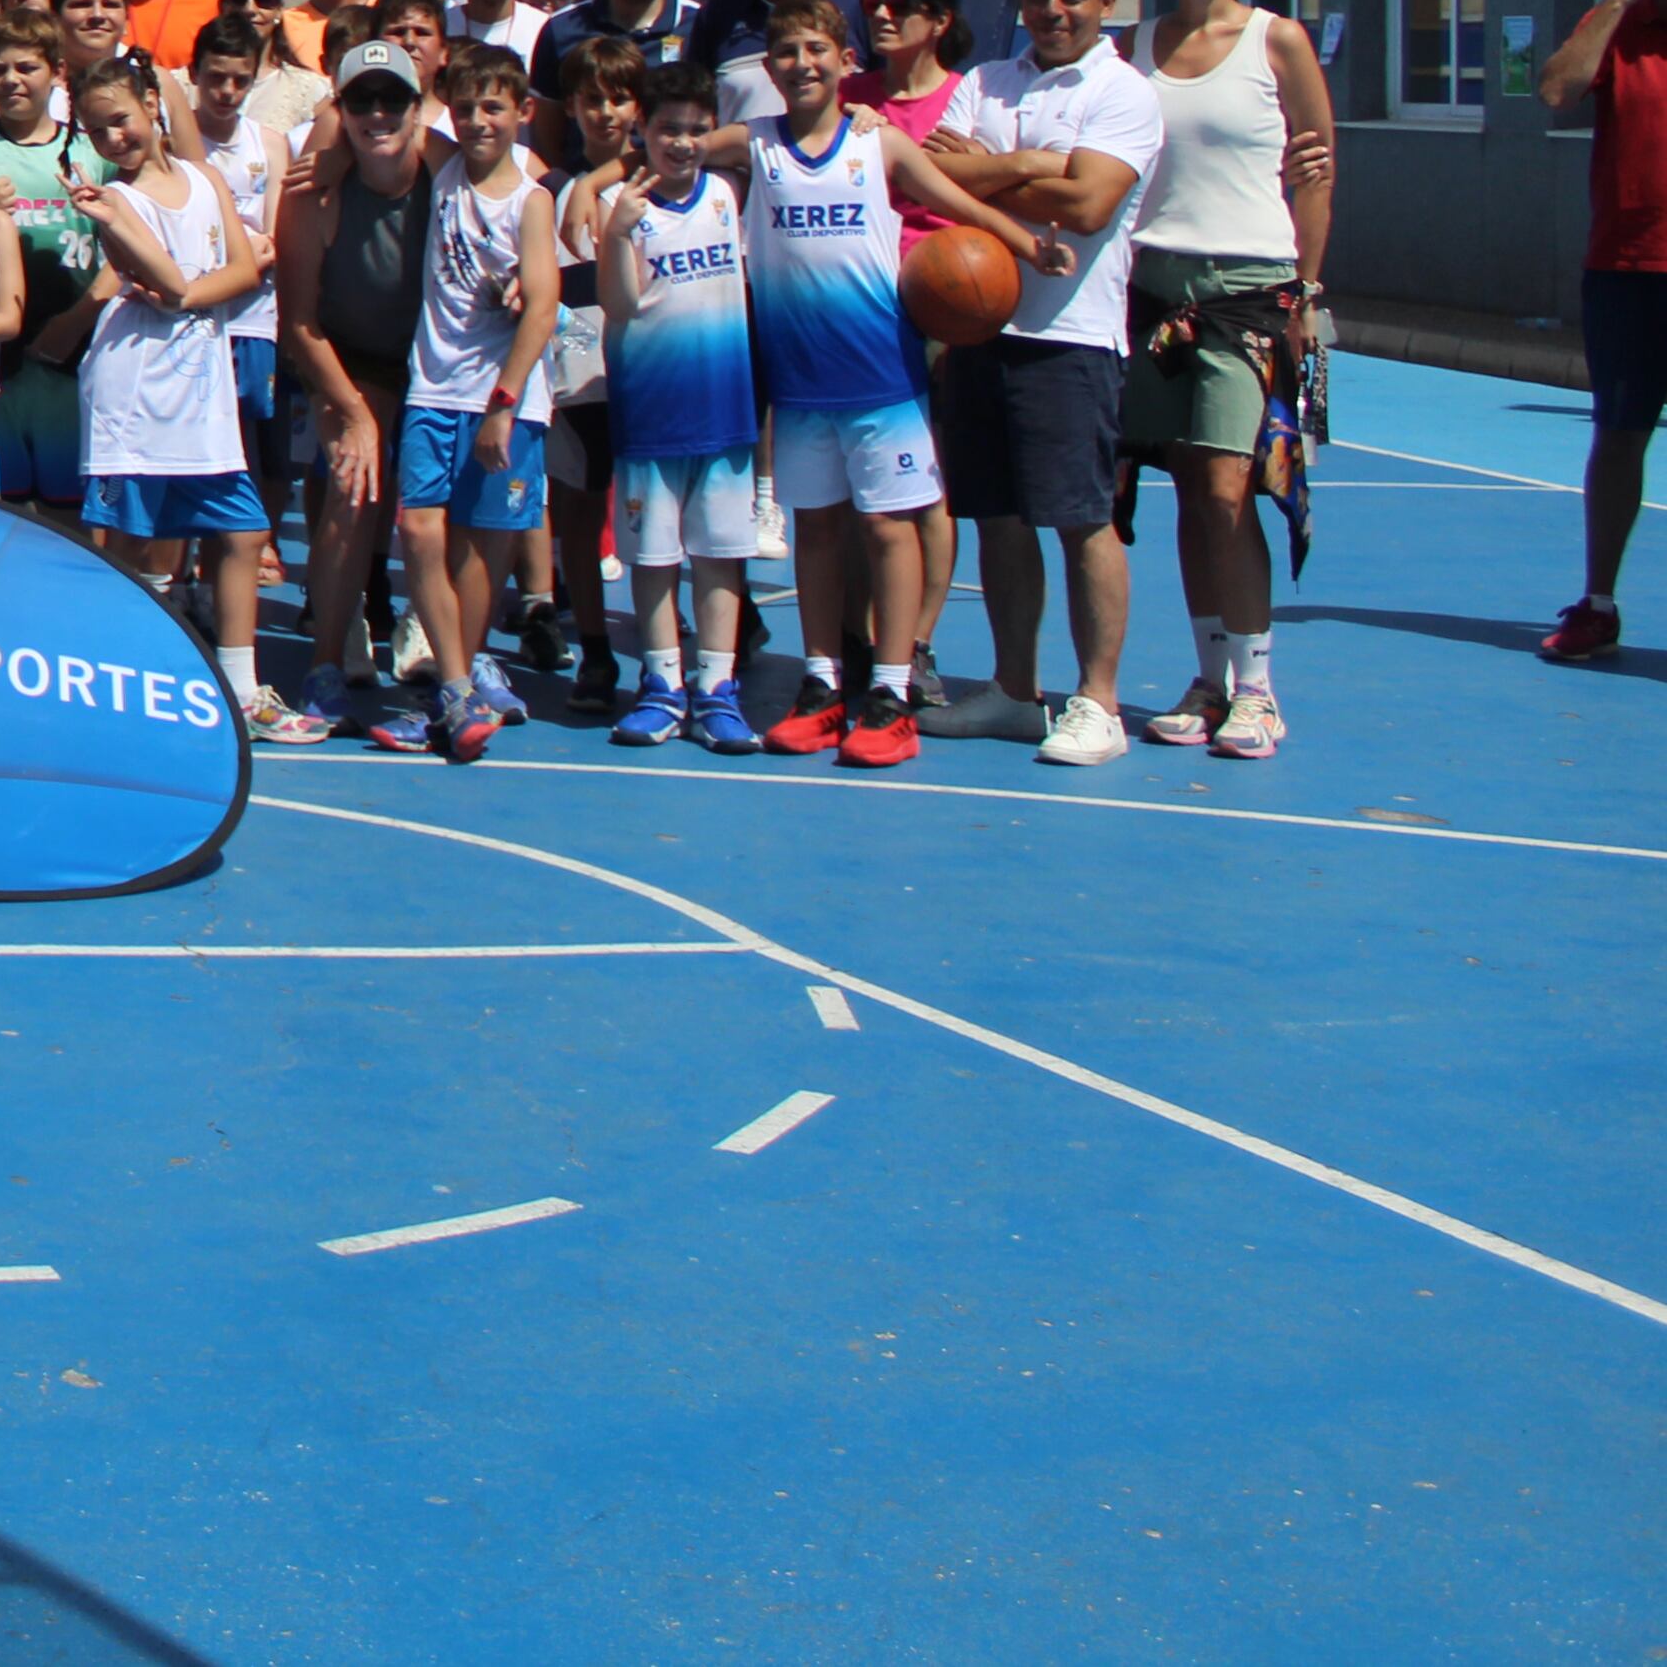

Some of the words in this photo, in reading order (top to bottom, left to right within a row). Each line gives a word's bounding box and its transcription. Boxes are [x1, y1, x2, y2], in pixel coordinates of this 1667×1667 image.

[771, 203, 866, 230] XEREZ
[786, 228, 810, 239] CLUB
[811, 228, 867, 238] DEPORTIVO
[647, 243, 735, 280] XEREZ
[670, 272, 695, 285] CLUB
